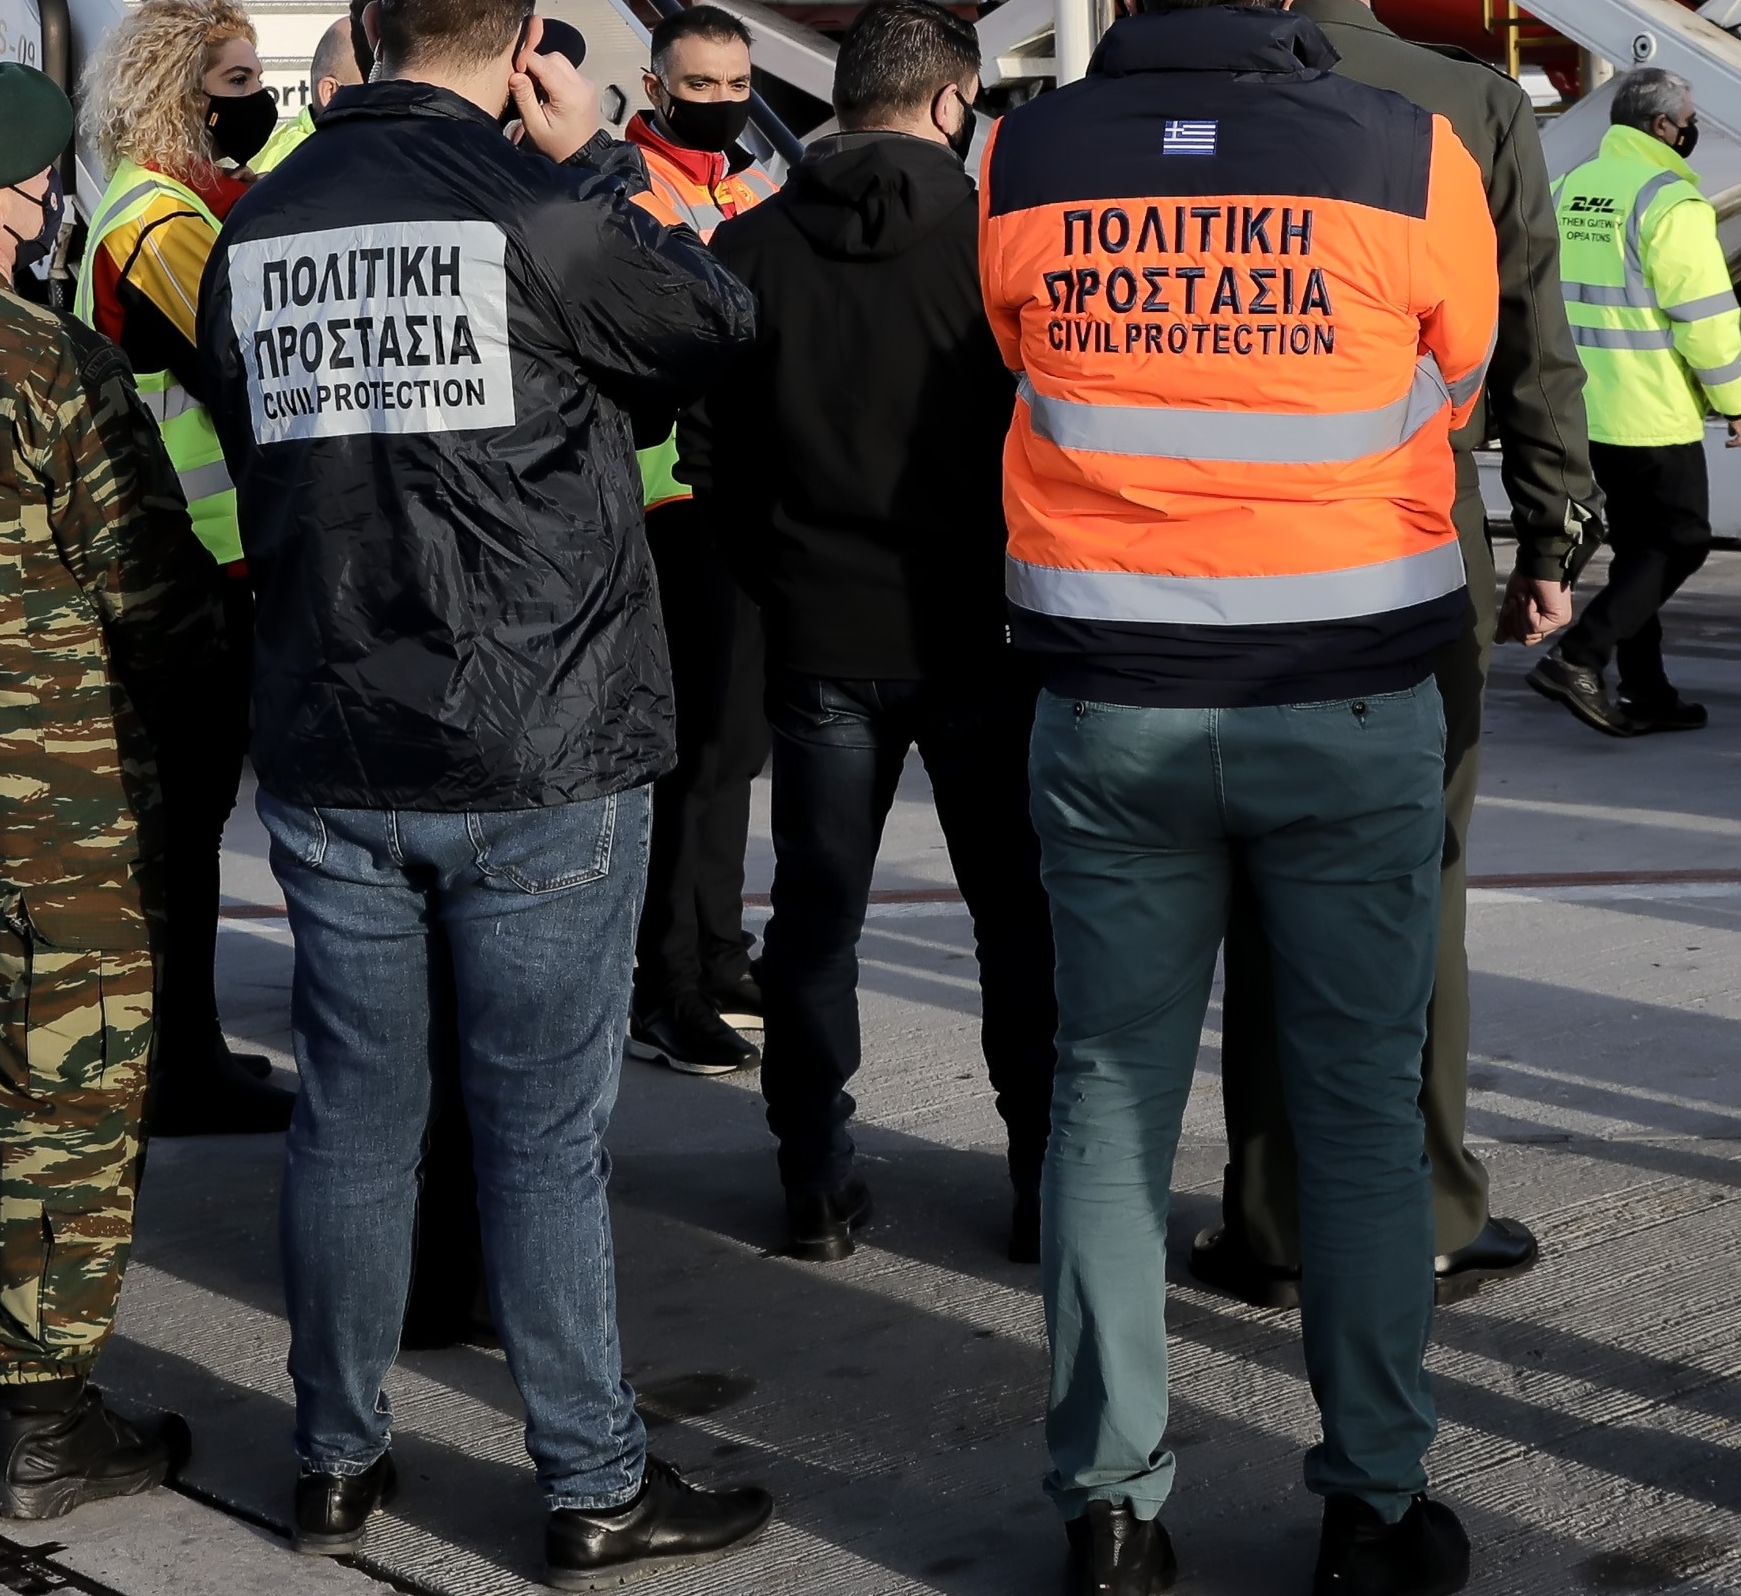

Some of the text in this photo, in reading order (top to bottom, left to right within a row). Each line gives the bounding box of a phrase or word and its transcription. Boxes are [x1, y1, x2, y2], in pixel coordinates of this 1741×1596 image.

[1569, 196, 1615, 213] DHL
[1063, 206, 1313, 256] ΠΟΛΙΤΙΚΗ
[263, 246, 460, 311] ΠΟΛΙΤΙΚΗ
[1043, 266, 1332, 316] ΠΡΟΣΤΑΣΙΑ
[254, 315, 481, 380] ΠΡΟΣΤΑΣΙΑ
[1048, 319, 1334, 355] CIVIL PROTECTION
[263, 378, 485, 419] CIVIL PROTECTION
